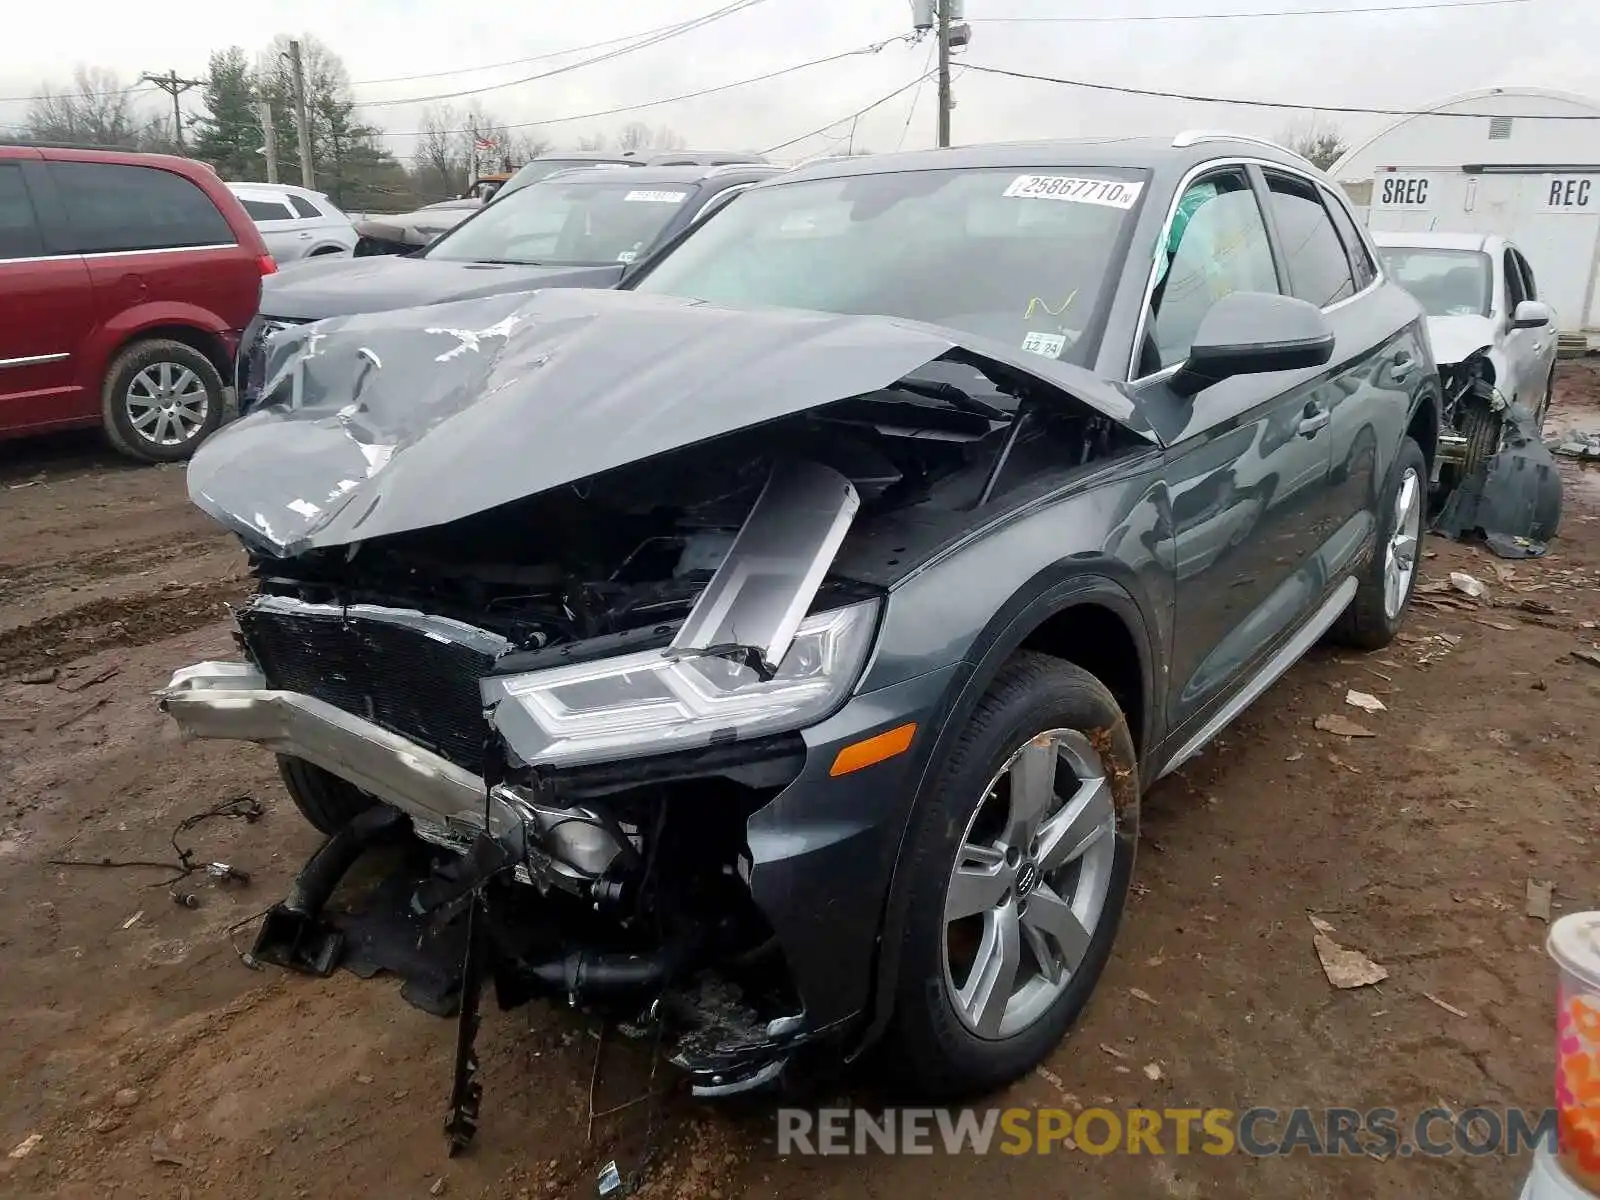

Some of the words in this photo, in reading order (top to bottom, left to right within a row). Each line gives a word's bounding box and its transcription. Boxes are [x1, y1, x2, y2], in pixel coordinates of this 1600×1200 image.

[1022, 177, 1125, 201] 25867710
[1382, 178, 1429, 204] SREC
[1548, 179, 1591, 206] REC
[1025, 341, 1041, 352] 12
